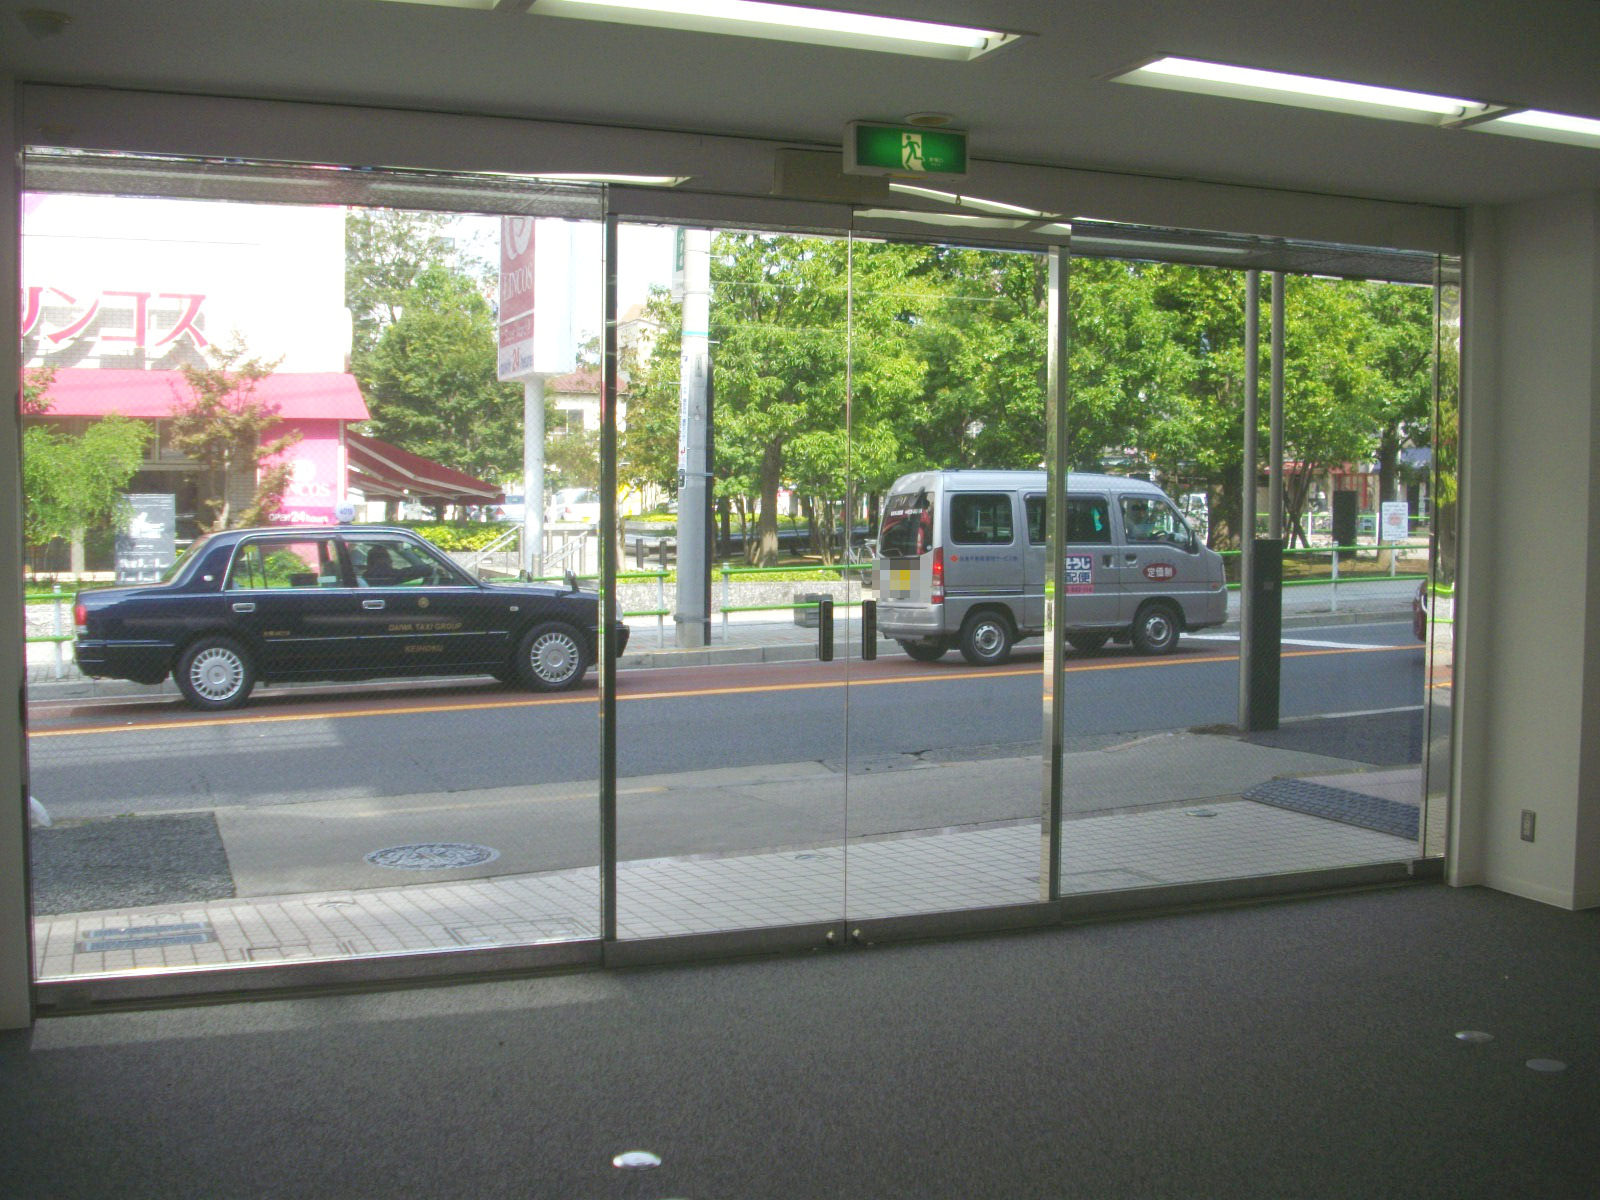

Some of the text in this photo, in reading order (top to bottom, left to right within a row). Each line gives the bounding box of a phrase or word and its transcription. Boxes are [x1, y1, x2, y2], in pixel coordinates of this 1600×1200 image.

[291, 511, 305, 522] 24
[415, 623, 433, 631] TAXI
[434, 622, 462, 630] GROUP
